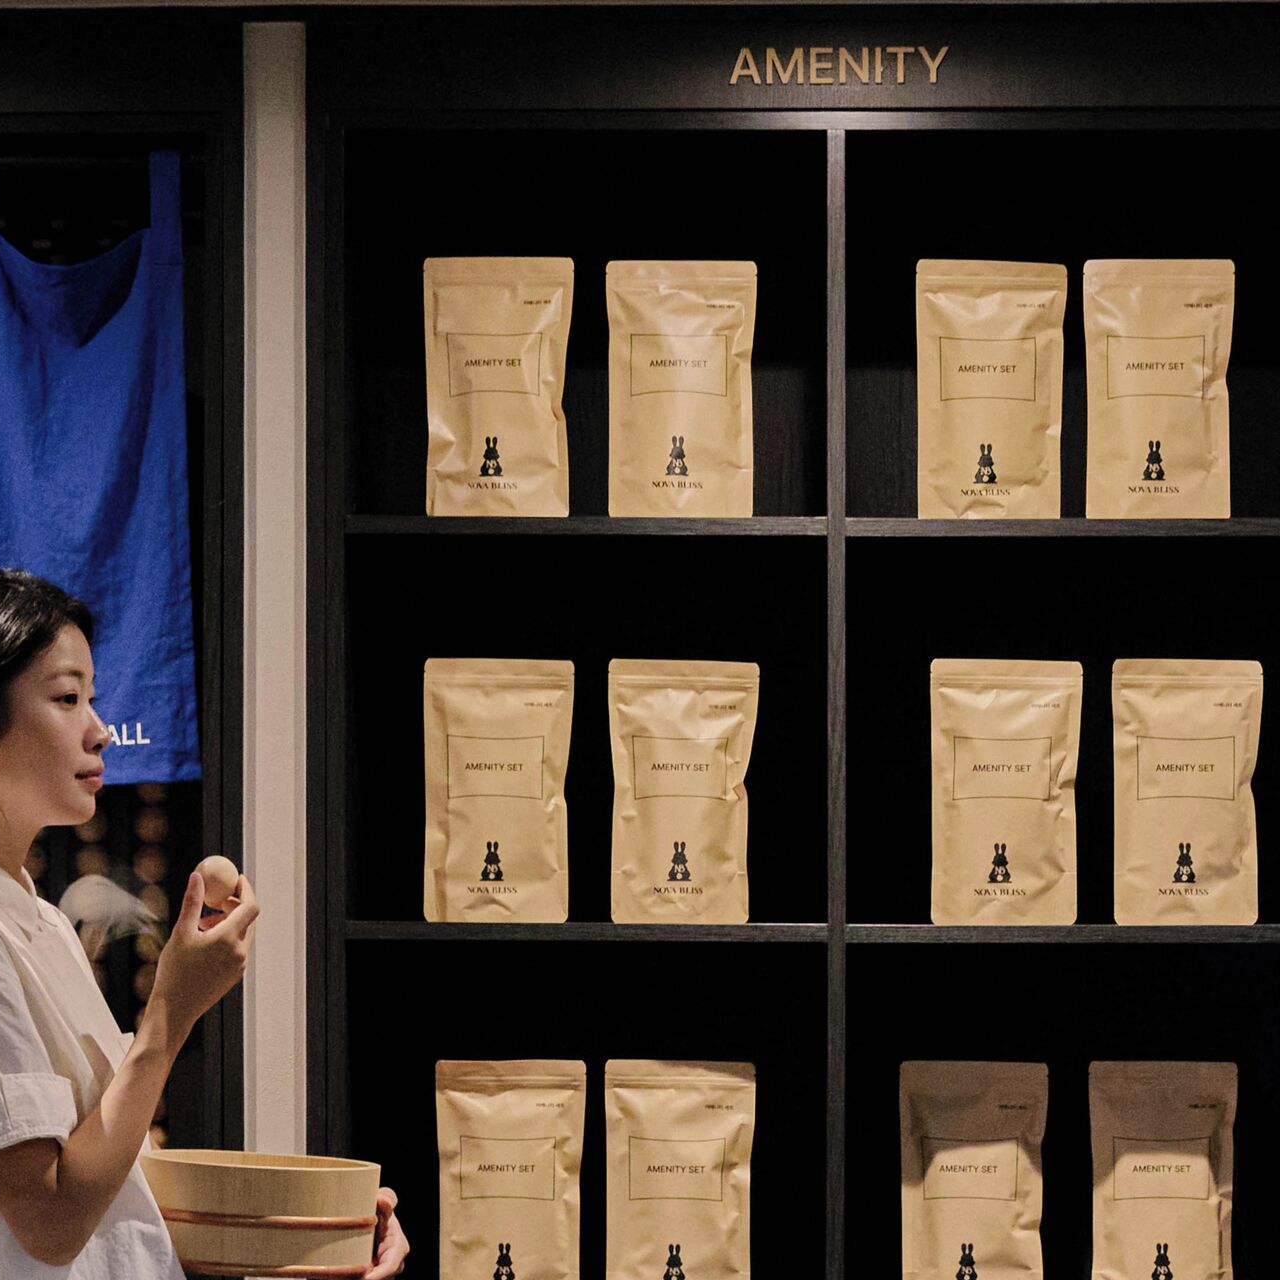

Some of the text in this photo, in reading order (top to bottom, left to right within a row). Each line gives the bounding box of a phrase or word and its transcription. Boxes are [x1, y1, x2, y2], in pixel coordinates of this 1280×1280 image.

[729, 46, 949, 85] AMENITY
[465, 358, 522, 368] AMENITY SET
[649, 360, 708, 368] AMENITY SET
[1126, 362, 1184, 370] AMENITY SET
[958, 365, 1017, 373] AMENITY SET
[107, 722, 150, 746] ALL
[465, 763, 523, 771] AMENITY SET
[651, 763, 710, 772] AMENITY SET
[972, 764, 1031, 773] AMENITY SET
[1156, 764, 1215, 772] AMENITY SET
[467, 886, 489, 894] NOVA
[653, 886, 676, 894] NOVA
[1158, 888, 1209, 896] NOVA BLISS
[477, 1164, 536, 1173] AMENITY SET
[647, 1165, 706, 1174] AMENITY SET
[939, 1165, 998, 1173] AMENITY SET
[1132, 1165, 1191, 1173] AMENITY SET
